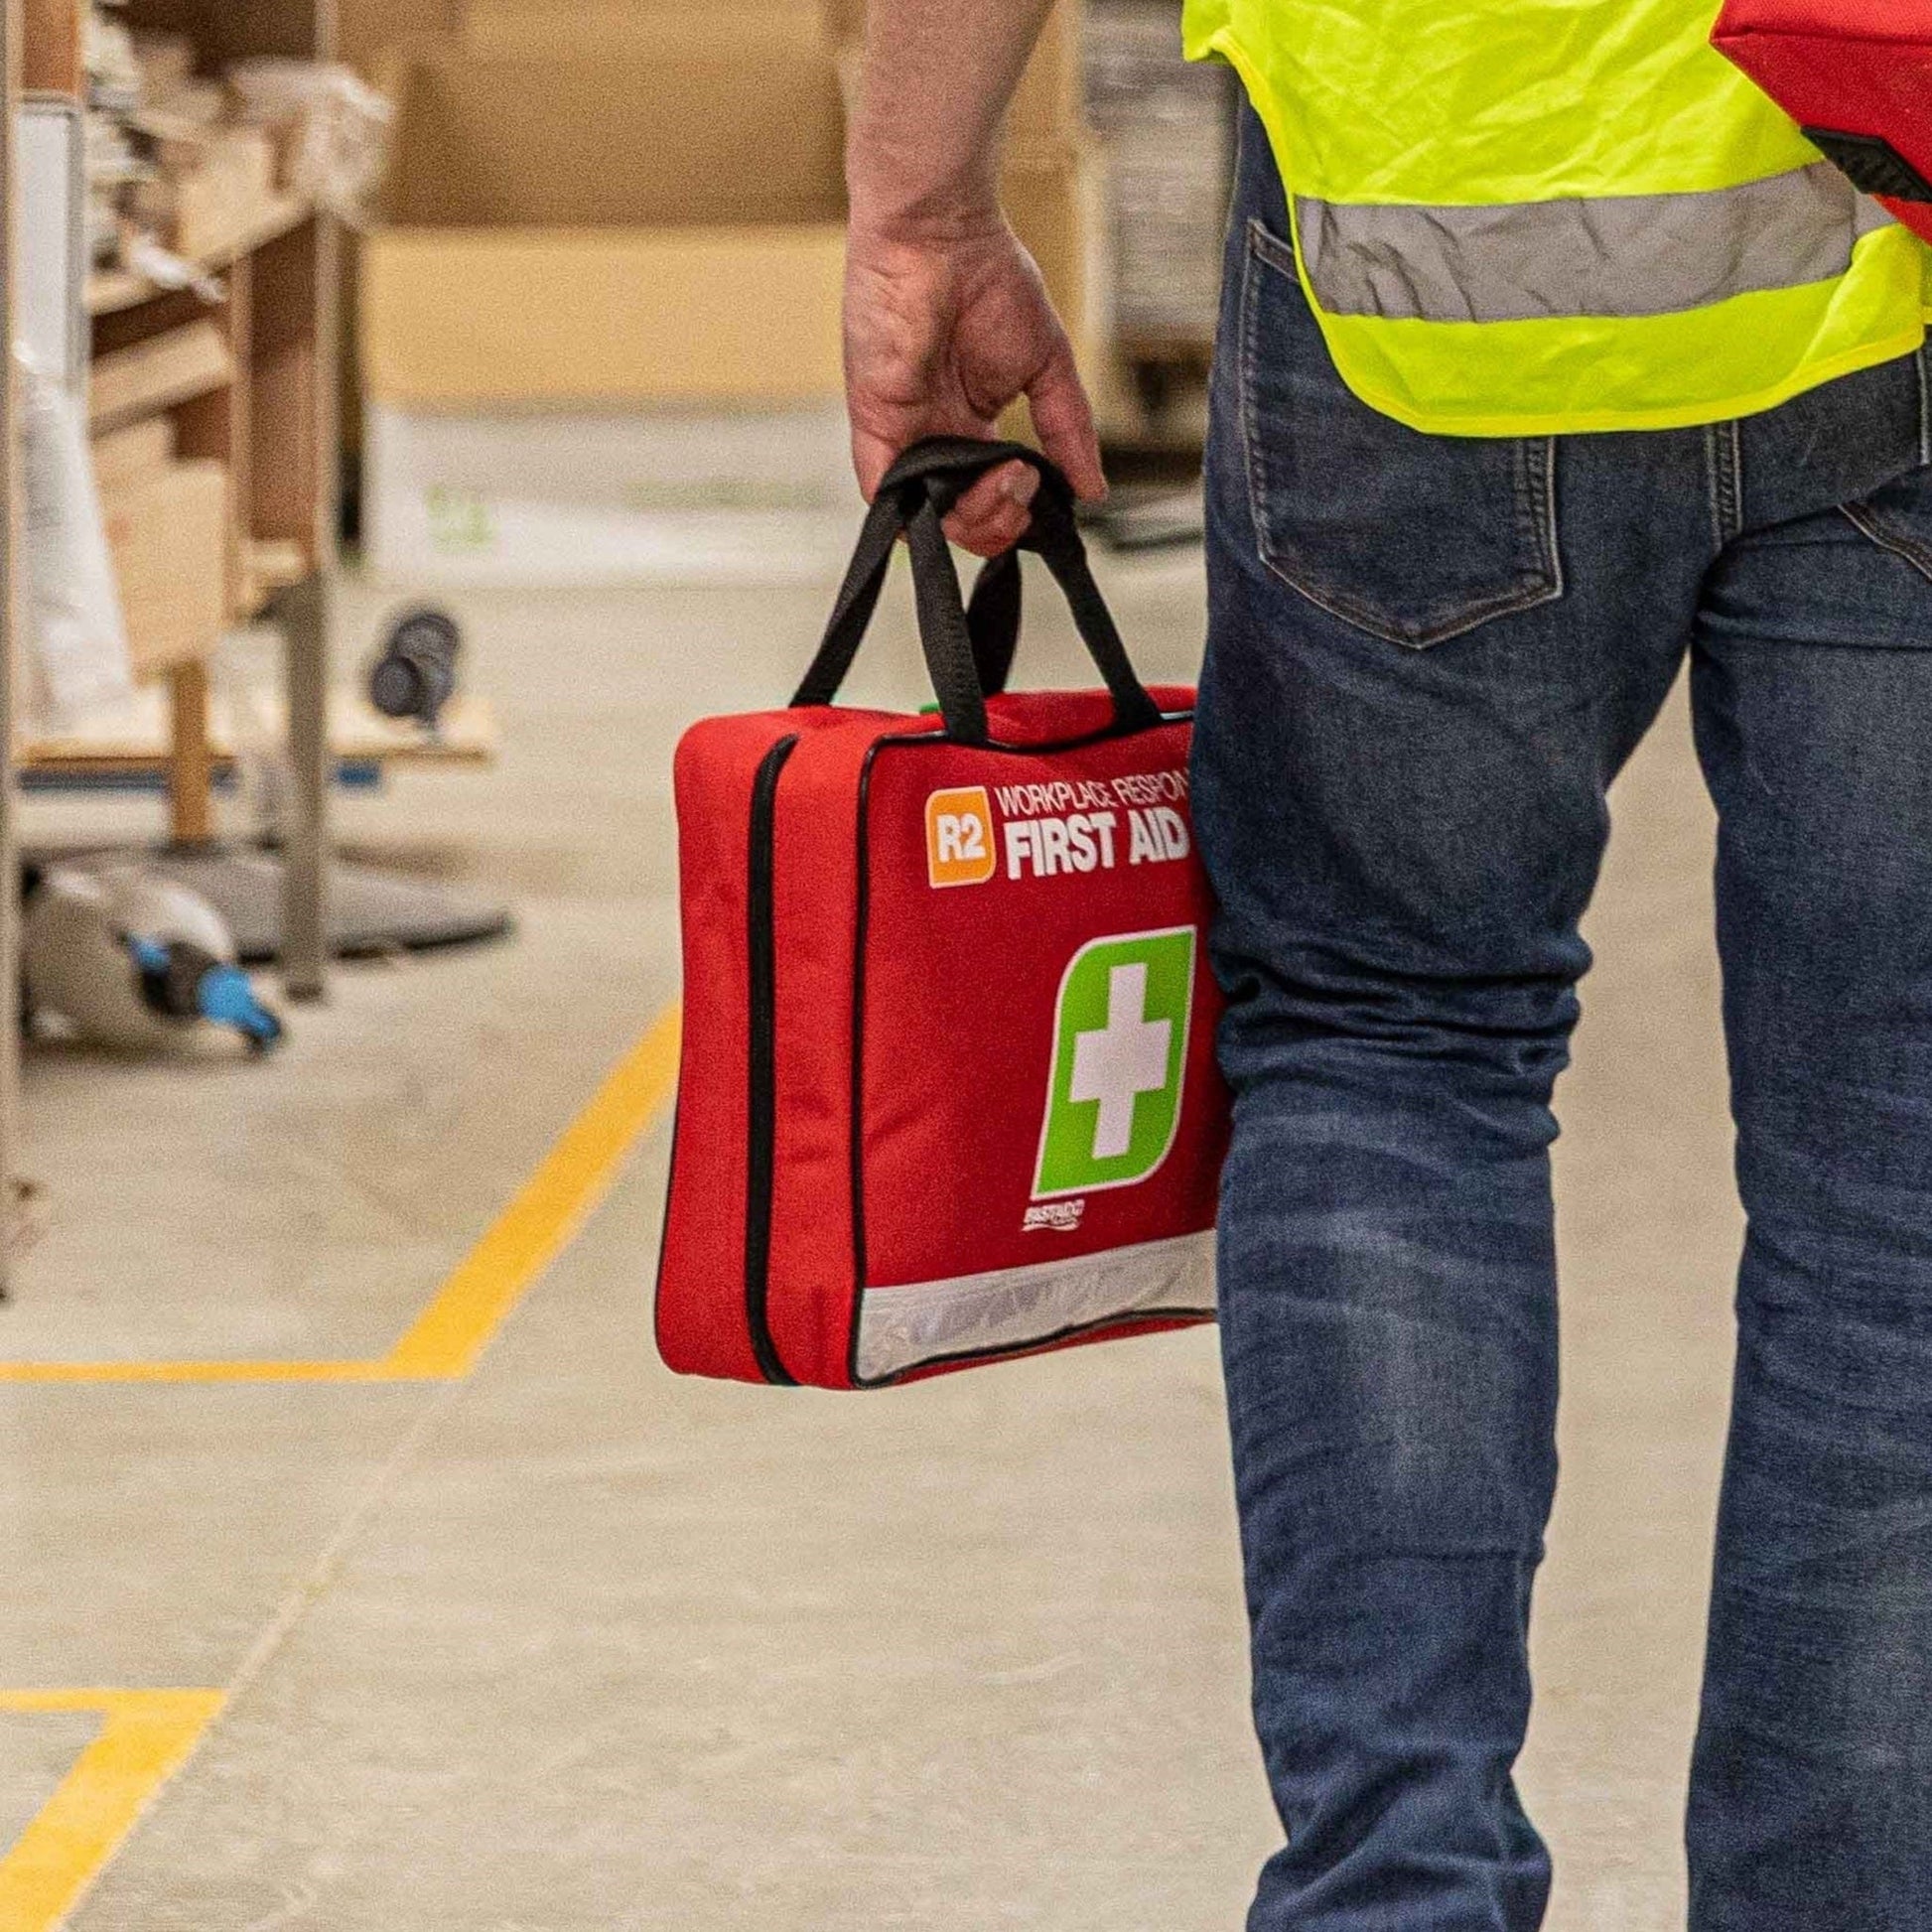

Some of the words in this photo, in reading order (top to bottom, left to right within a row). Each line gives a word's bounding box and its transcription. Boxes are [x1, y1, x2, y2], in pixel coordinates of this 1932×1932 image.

[994, 780, 1119, 817] WORKPLACE
[937, 814, 986, 862] R2
[1003, 812, 1117, 880] FIRST
[1128, 805, 1190, 864] AID
